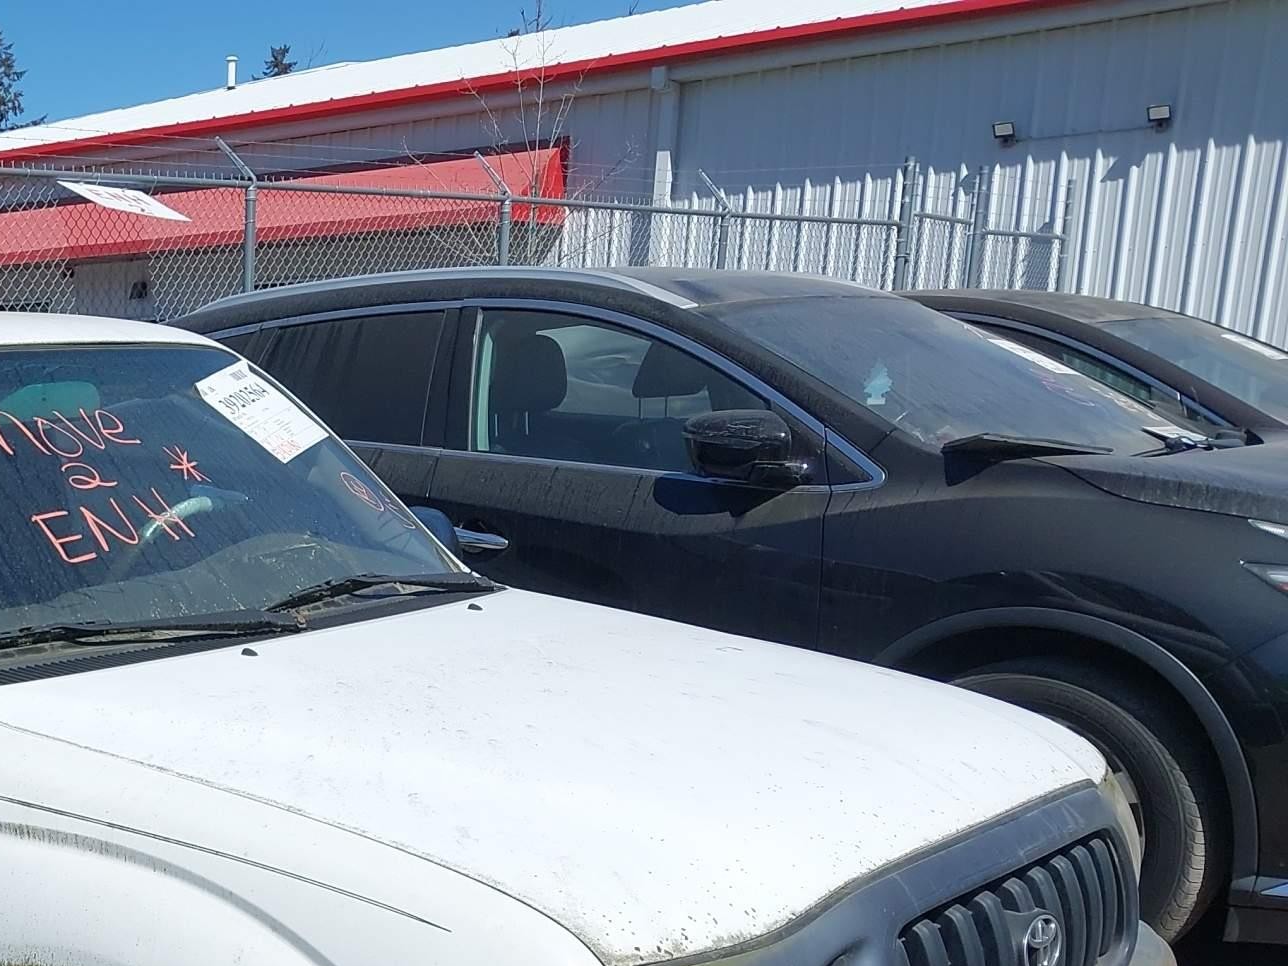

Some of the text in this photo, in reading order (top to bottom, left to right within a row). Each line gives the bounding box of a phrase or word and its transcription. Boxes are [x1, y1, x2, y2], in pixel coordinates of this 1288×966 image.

[217, 382, 271, 415] 39202564
[60, 462, 118, 491] 2
[30, 487, 197, 564] ENH
